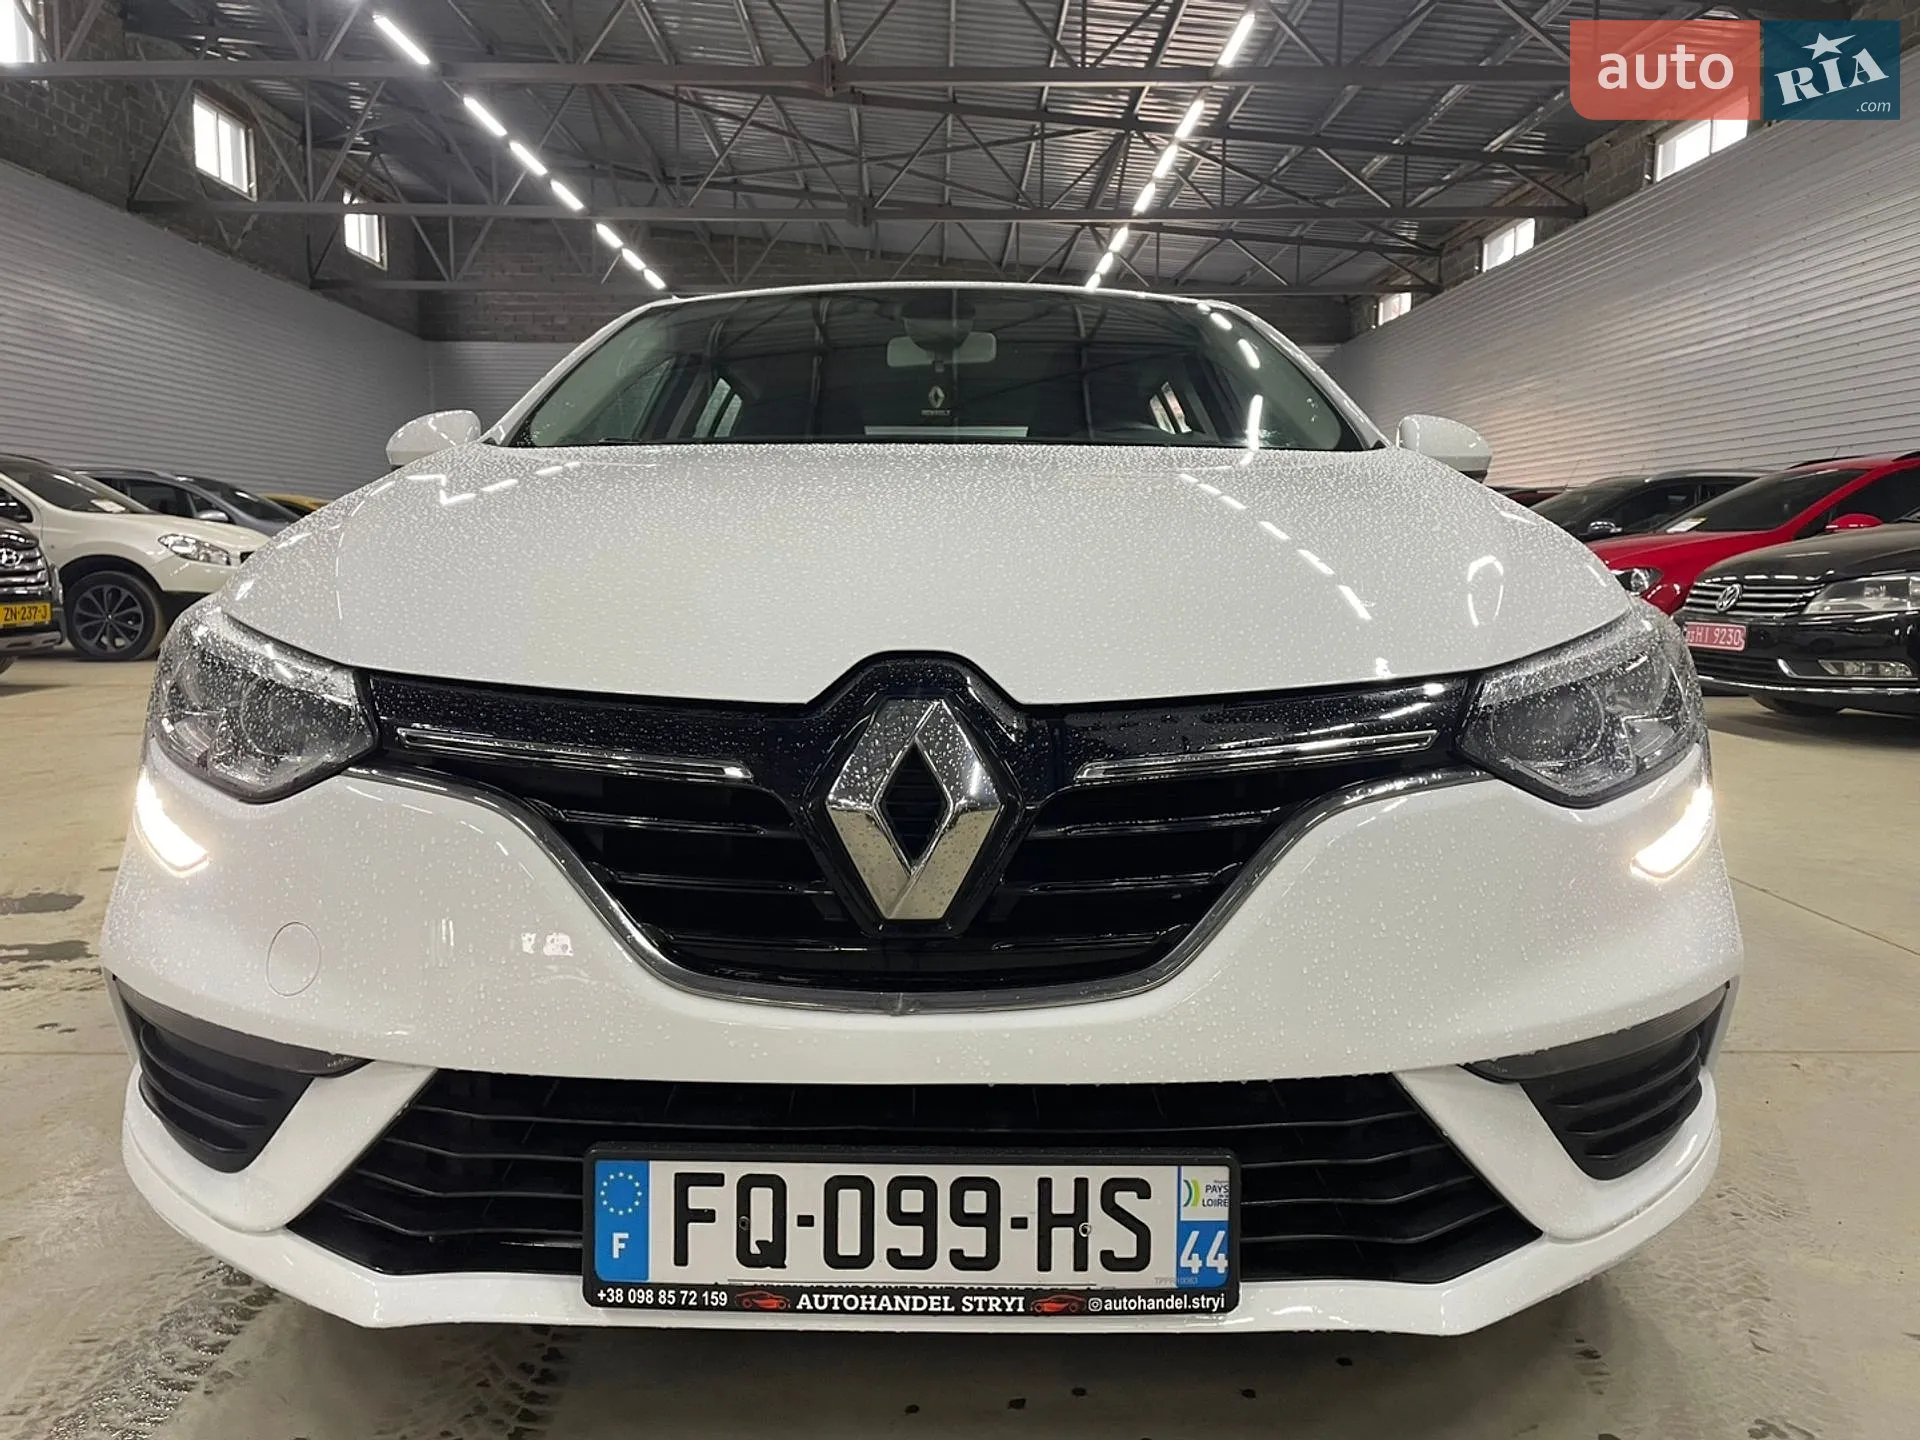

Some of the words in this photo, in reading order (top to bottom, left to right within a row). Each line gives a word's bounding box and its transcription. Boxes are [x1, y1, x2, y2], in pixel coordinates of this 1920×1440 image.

[1713, 628, 1741, 646] 9230
[1205, 1184, 1229, 1194] PAYS
[674, 1172, 1151, 1271] FQ-099-HS
[612, 1232, 629, 1259] F
[1181, 1230, 1229, 1274] 44
[597, 1288, 624, 1303] +38
[628, 1289, 654, 1304] 098
[658, 1290, 676, 1305] 85
[680, 1291, 698, 1306] 72
[702, 1291, 728, 1307] 159
[796, 1294, 955, 1312] AUTOHANDEL
[961, 1296, 1025, 1312] STRYI
[1103, 1293, 1226, 1312] autohandel.stryi
